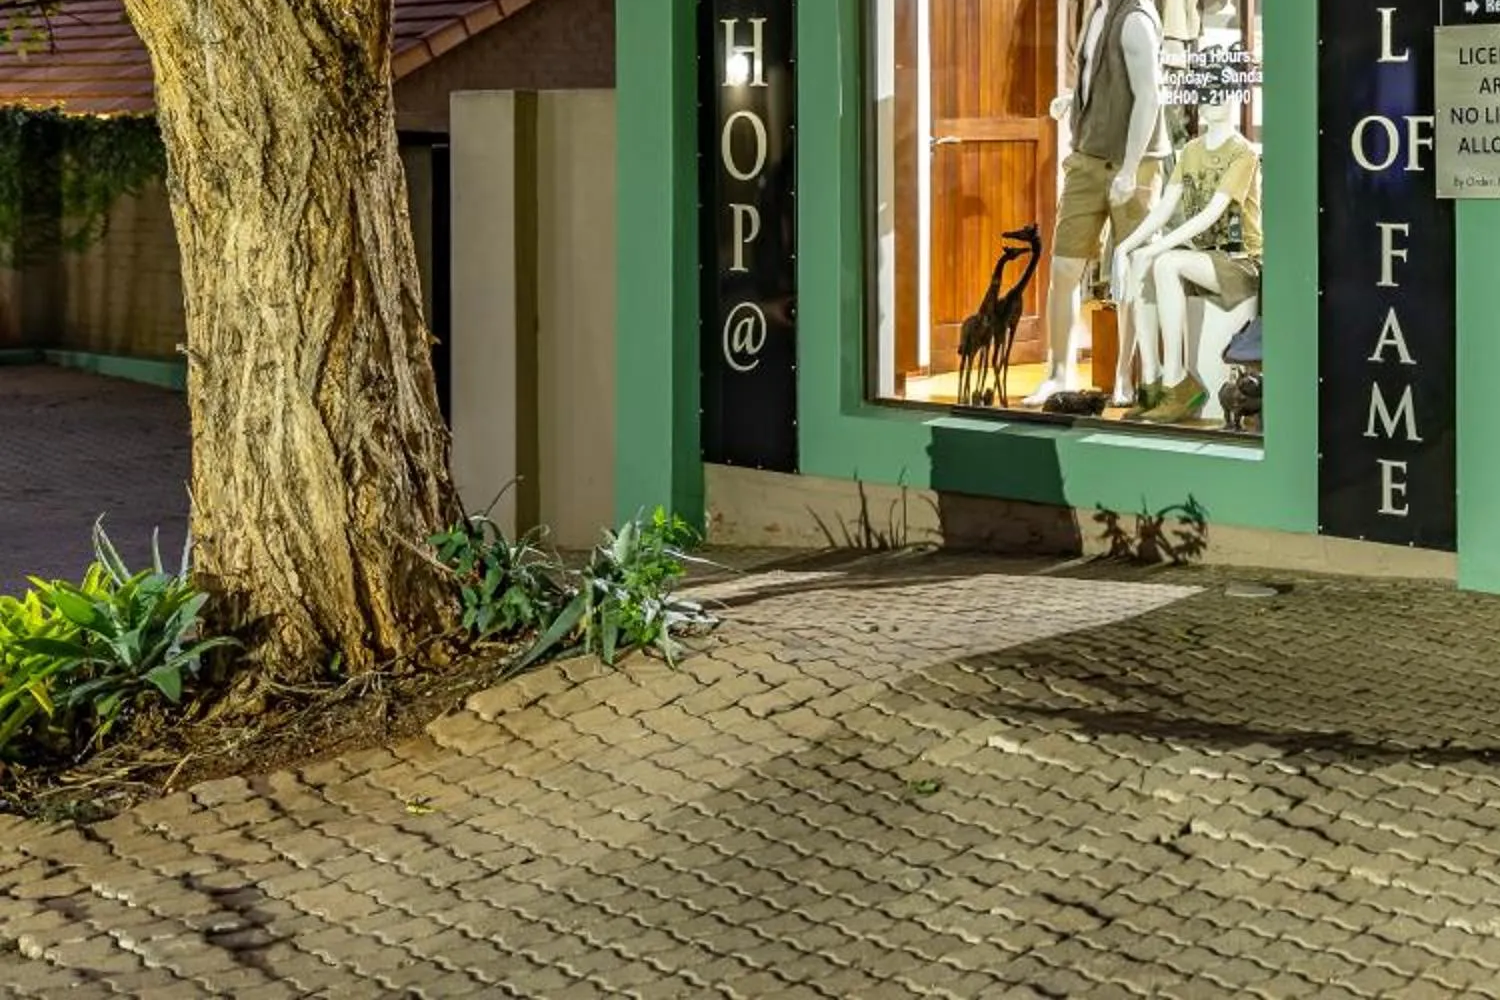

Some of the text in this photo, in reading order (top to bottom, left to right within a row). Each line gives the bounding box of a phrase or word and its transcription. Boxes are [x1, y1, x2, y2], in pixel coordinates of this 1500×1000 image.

[1158, 88, 1199, 104] 8H00
[1451, 107, 1479, 124] NO
[1351, 115, 1435, 171] OF
[1363, 222, 1424, 517] FAME
